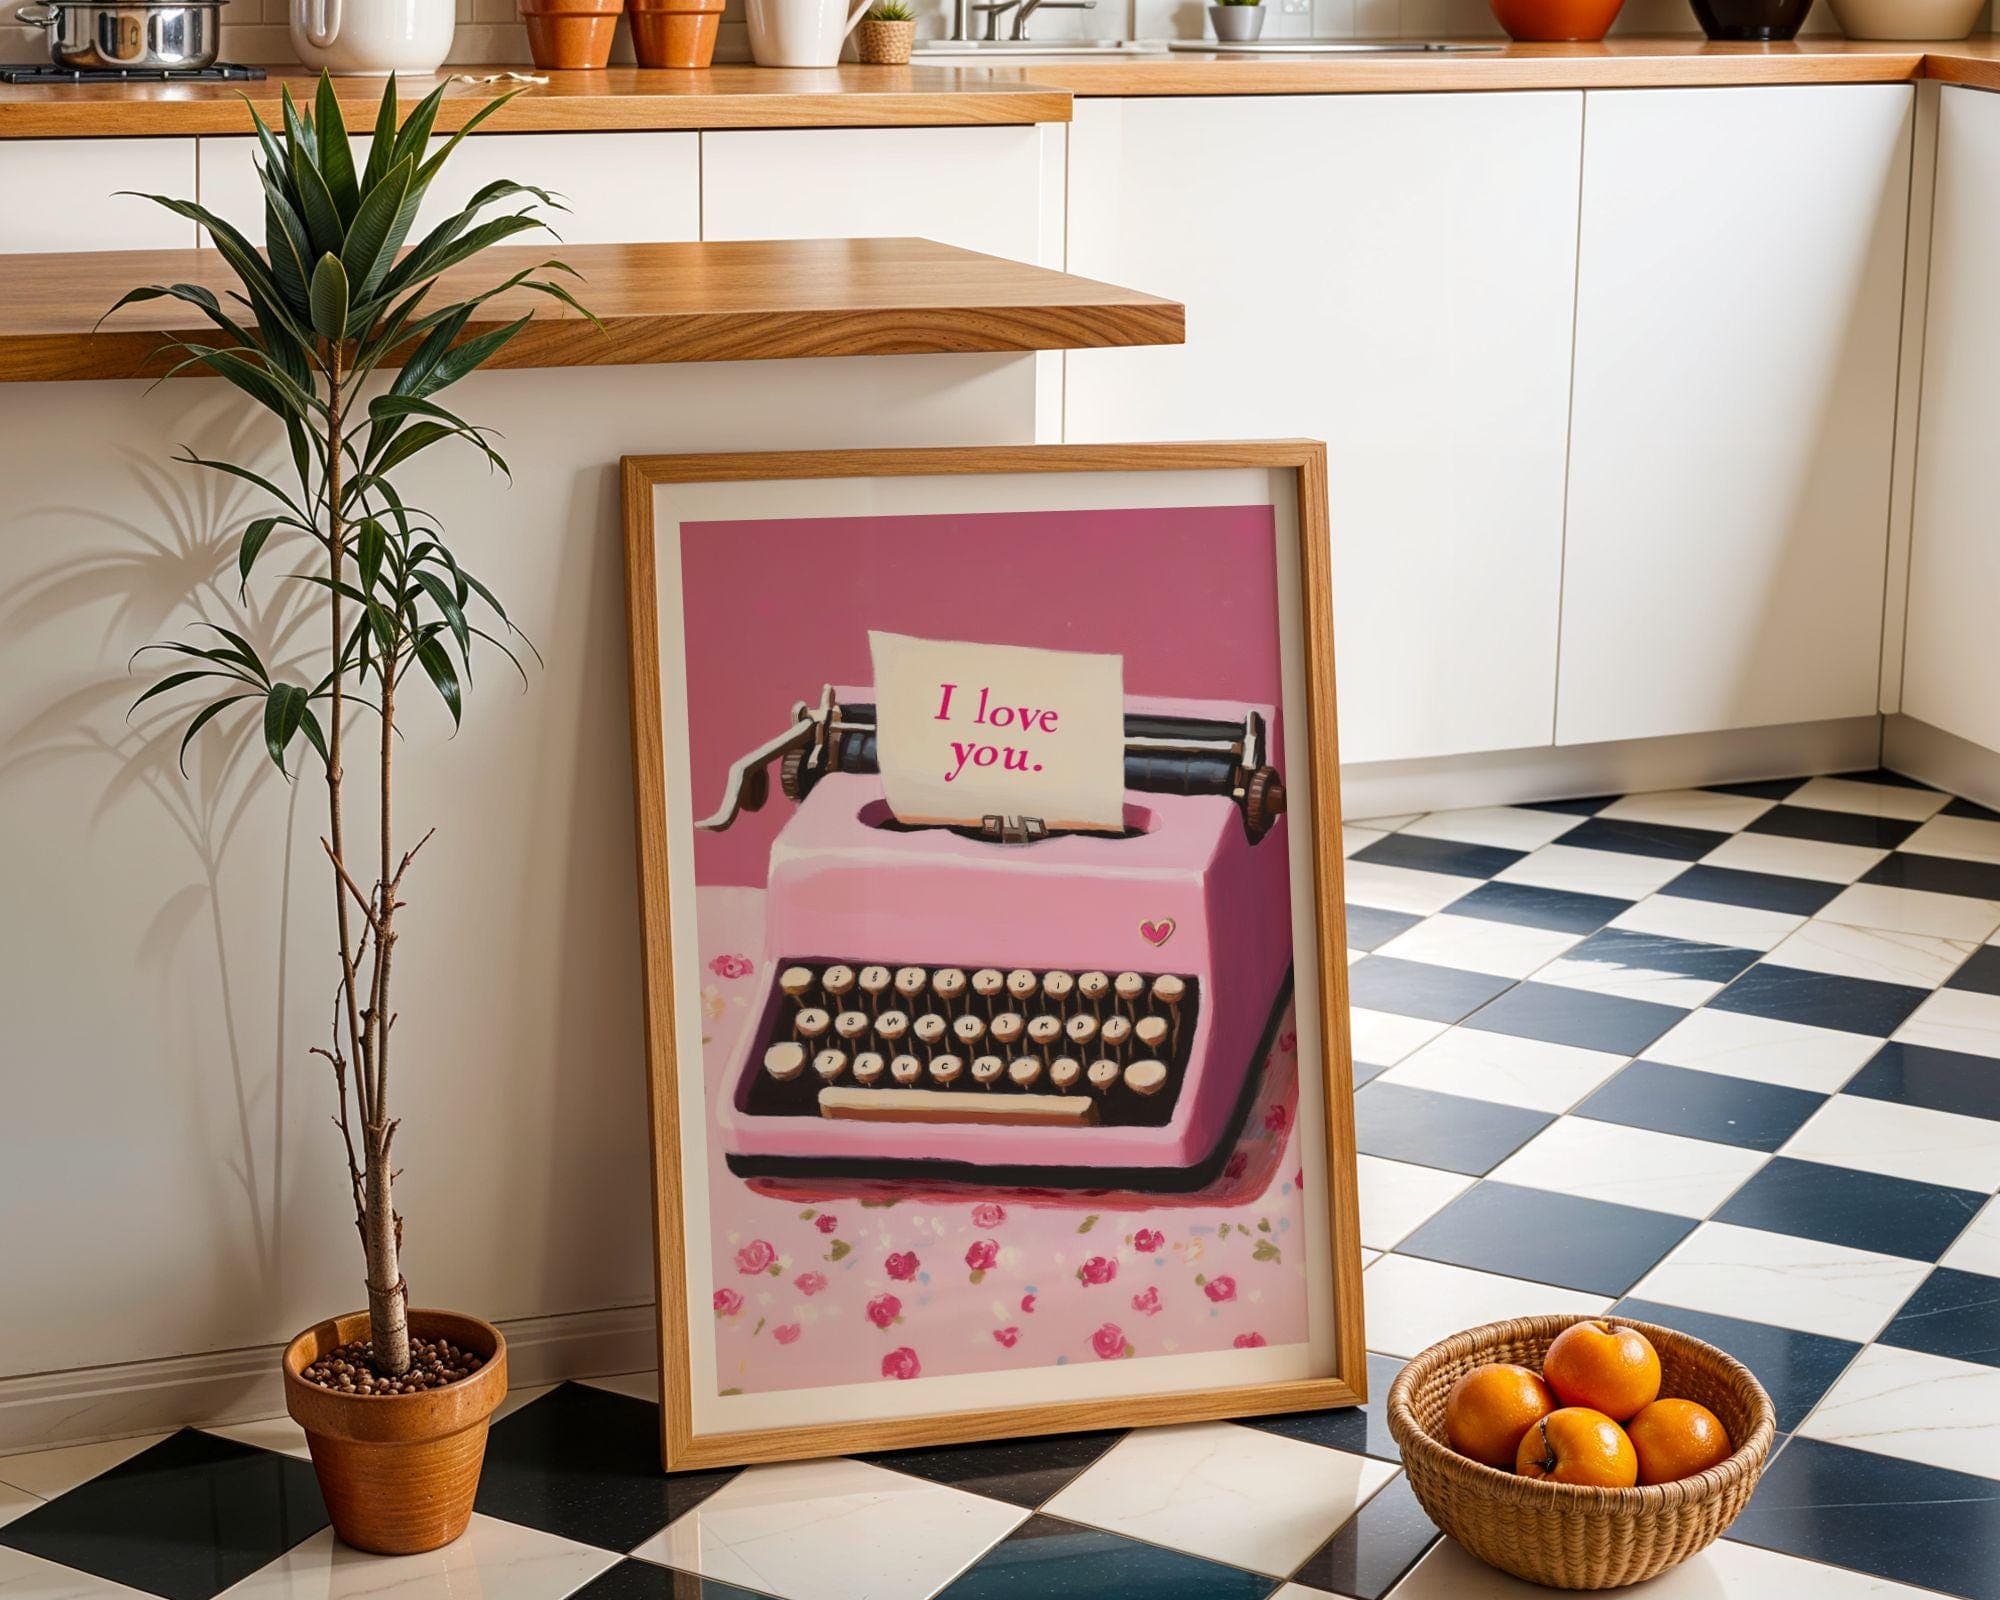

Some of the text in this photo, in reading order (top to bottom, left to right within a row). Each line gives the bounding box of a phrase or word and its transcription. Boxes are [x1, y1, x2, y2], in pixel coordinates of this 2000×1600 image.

[934, 683, 1058, 733] I love
[944, 741, 1043, 782] you.
[806, 1015, 815, 1023] A
[887, 1018, 899, 1026] W
[926, 1021, 935, 1030] F
[980, 1063, 991, 1071] N
